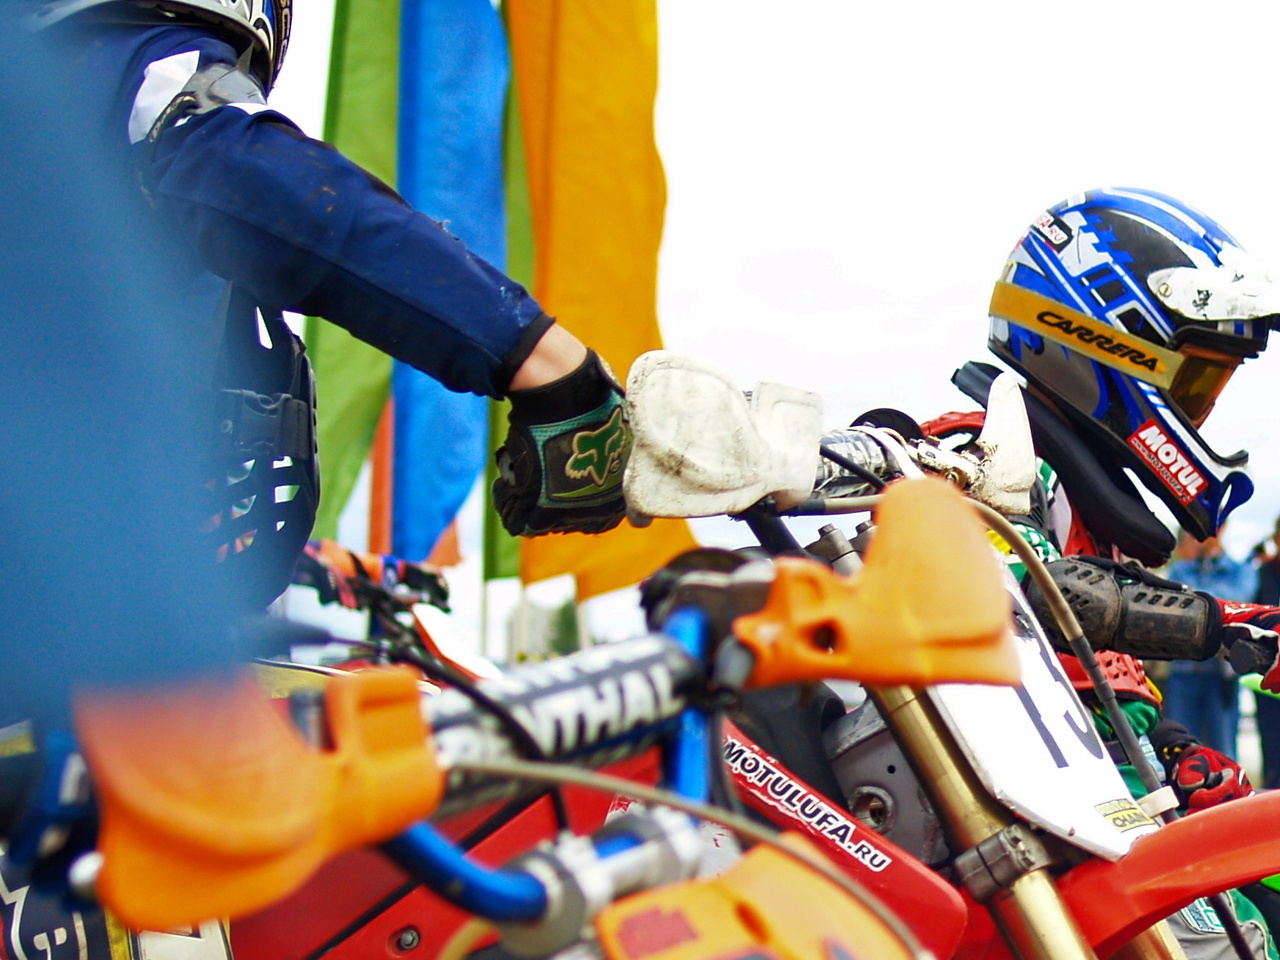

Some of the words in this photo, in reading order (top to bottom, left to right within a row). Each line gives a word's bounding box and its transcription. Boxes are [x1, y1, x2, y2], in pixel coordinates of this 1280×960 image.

[1036, 310, 1160, 373] CARRERA
[1138, 425, 1204, 496] MOTUL
[723, 738, 890, 872] MOTULUFA.RU
